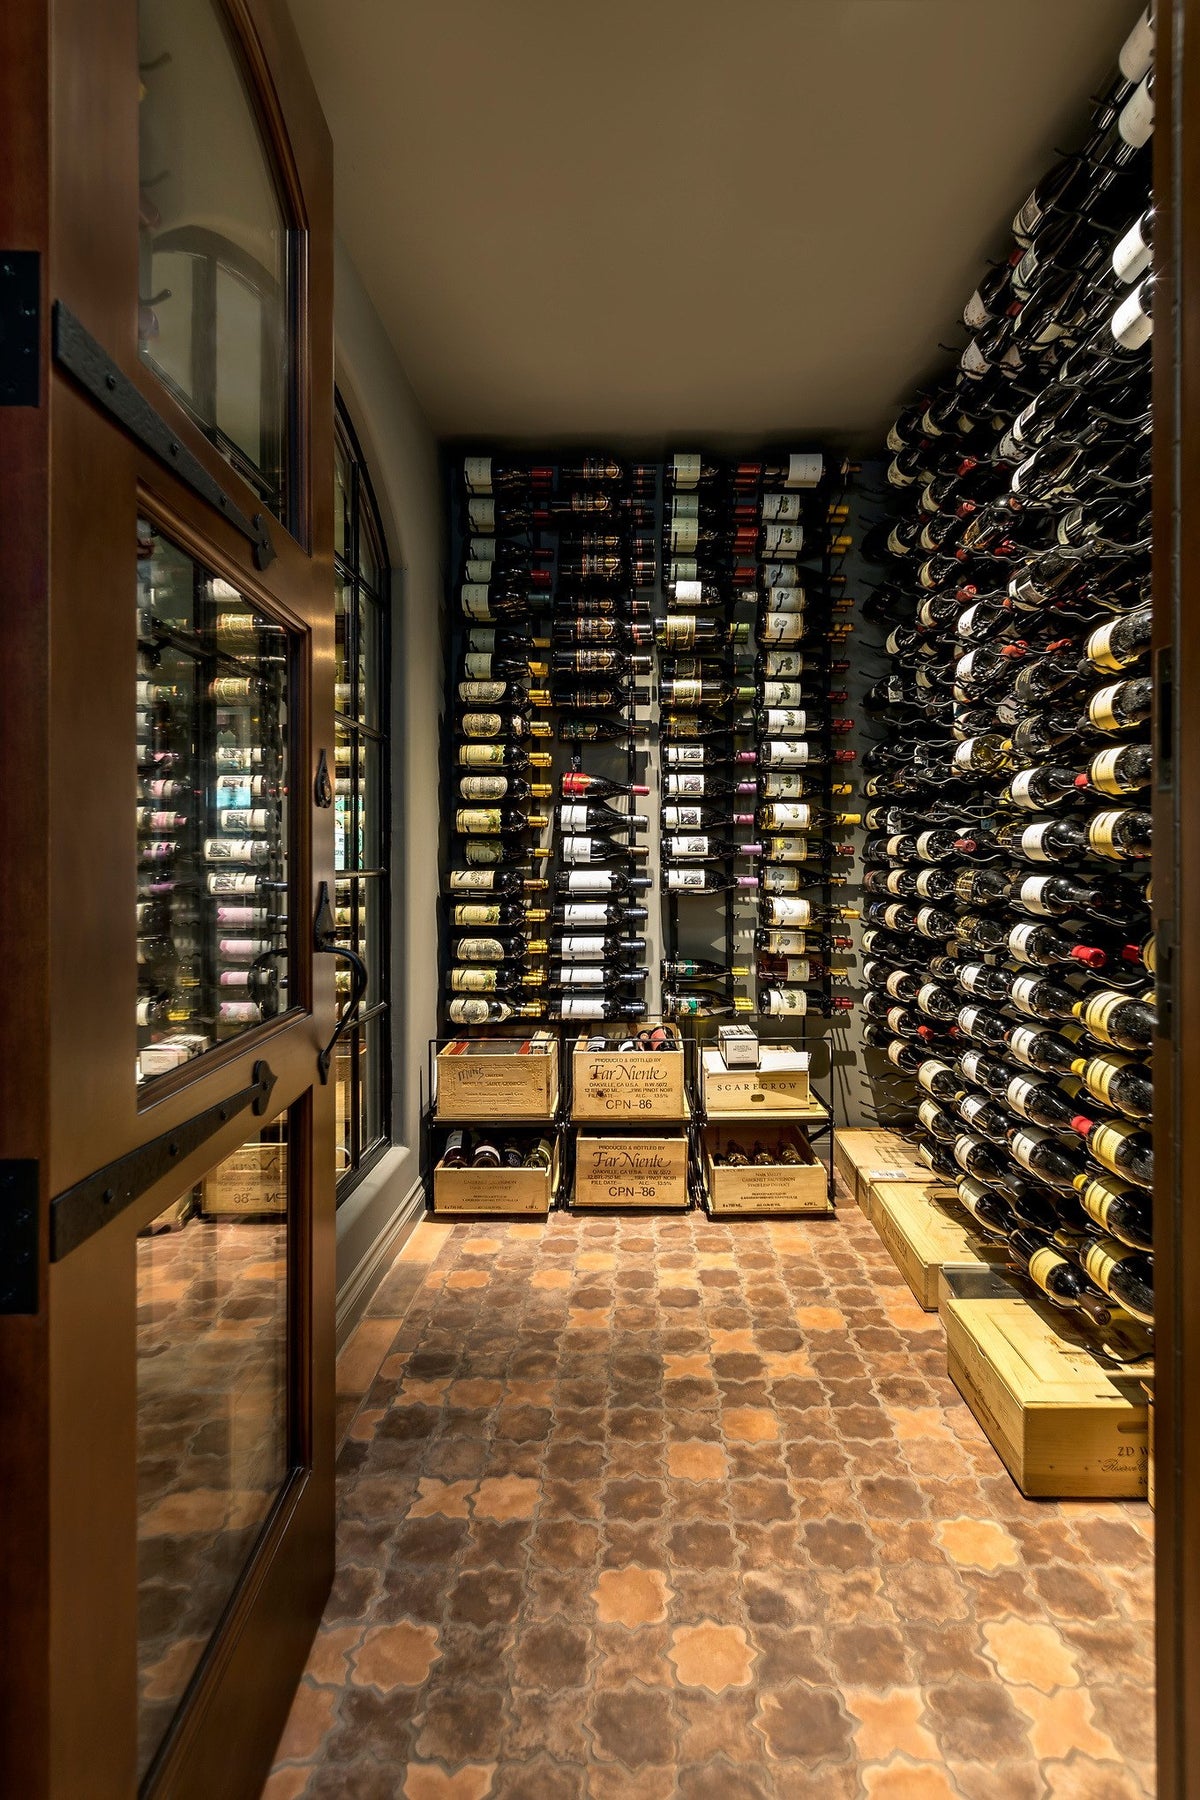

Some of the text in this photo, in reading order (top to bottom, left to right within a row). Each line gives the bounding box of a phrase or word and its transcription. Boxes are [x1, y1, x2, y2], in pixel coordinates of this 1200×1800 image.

[589, 1064, 668, 1081] Far Niente
[717, 1082, 797, 1091] SCARECROW
[605, 1099, 653, 1110] CPN-86
[592, 1151, 672, 1168] Far Niente
[608, 1186, 656, 1197] CPN-86
[1117, 1446, 1135, 1457] ZD
